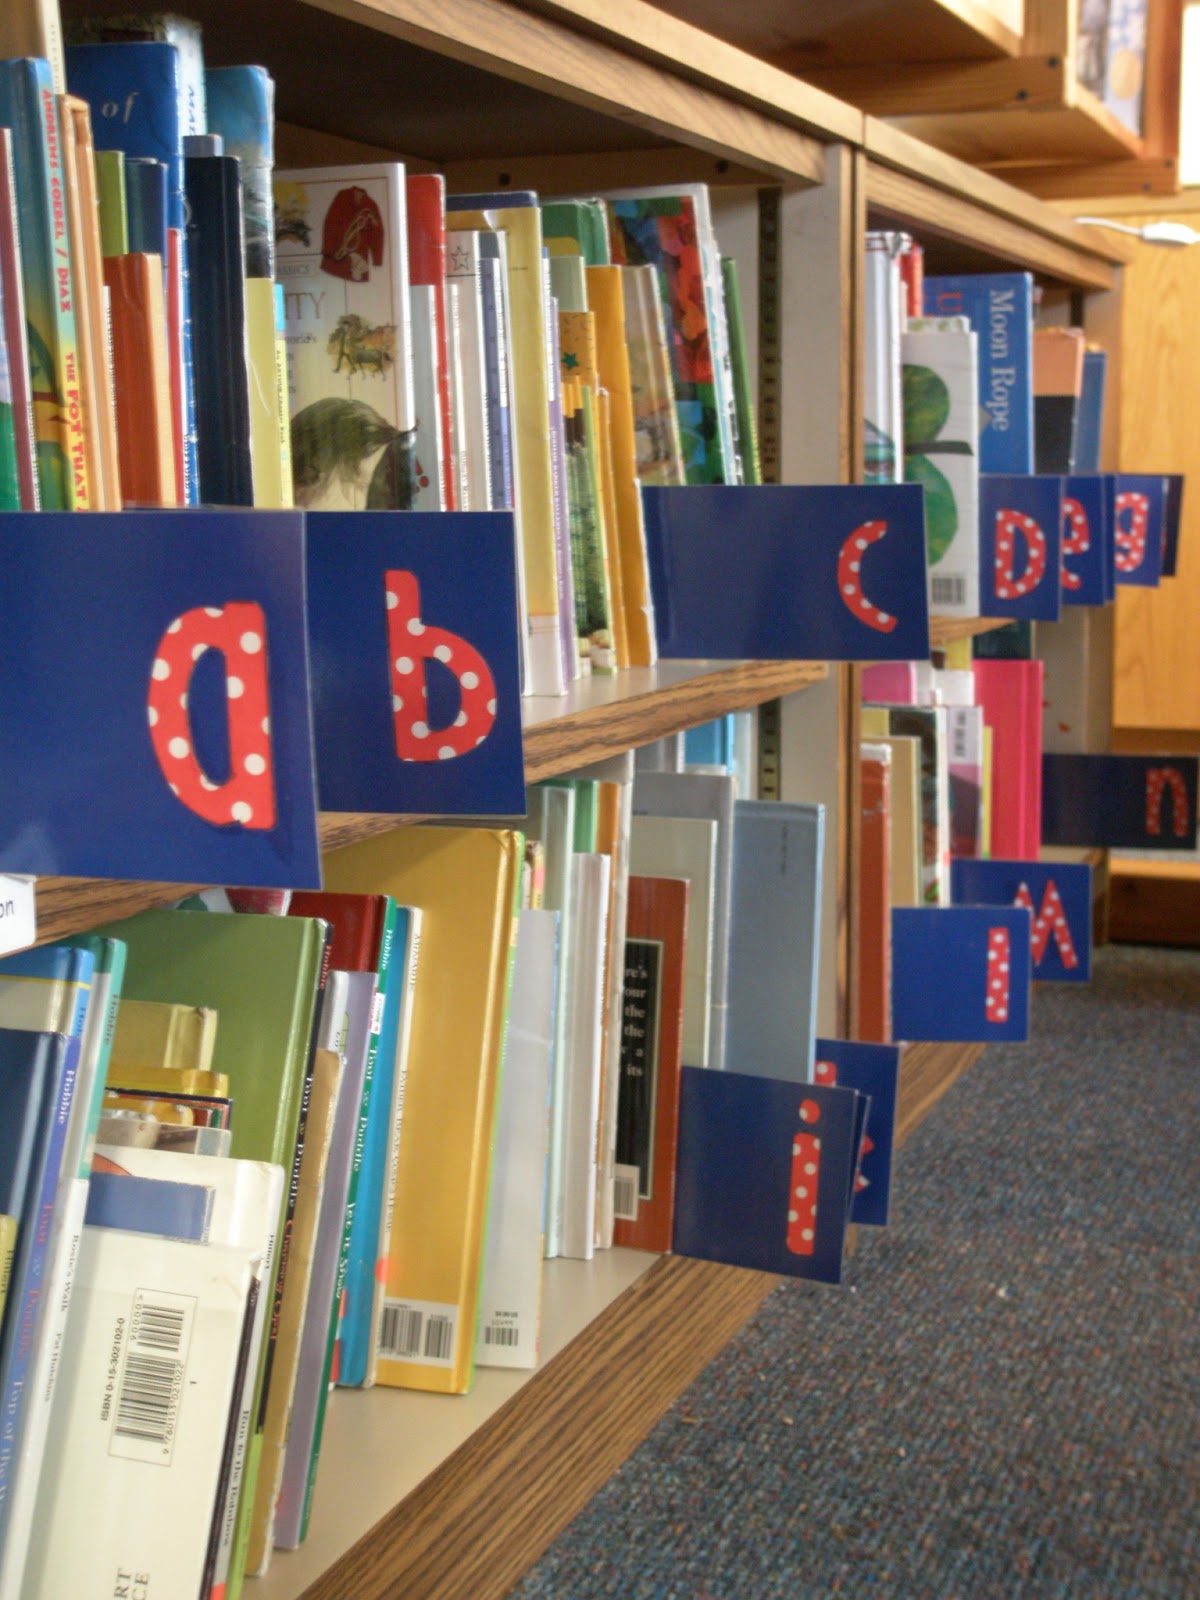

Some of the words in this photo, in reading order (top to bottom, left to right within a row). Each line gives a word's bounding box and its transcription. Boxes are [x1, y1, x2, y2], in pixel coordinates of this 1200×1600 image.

[102, 92, 139, 124] of
[989, 289, 1015, 360] Moon
[986, 367, 1016, 431] Rope
[995, 508, 1046, 599] D
[384, 569, 497, 762] b
[148, 602, 276, 830] a
[382, 929, 393, 970] Hobbie
[623, 1025, 645, 1037] the
[624, 1004, 646, 1018] the
[58, 1069, 76, 1125] Hobbie
[786, 1097, 821, 1256] i
[66, 1234, 80, 1278] Rosie's
[60, 1281, 72, 1312] Walk
[100, 1393, 113, 1422] ISBN
